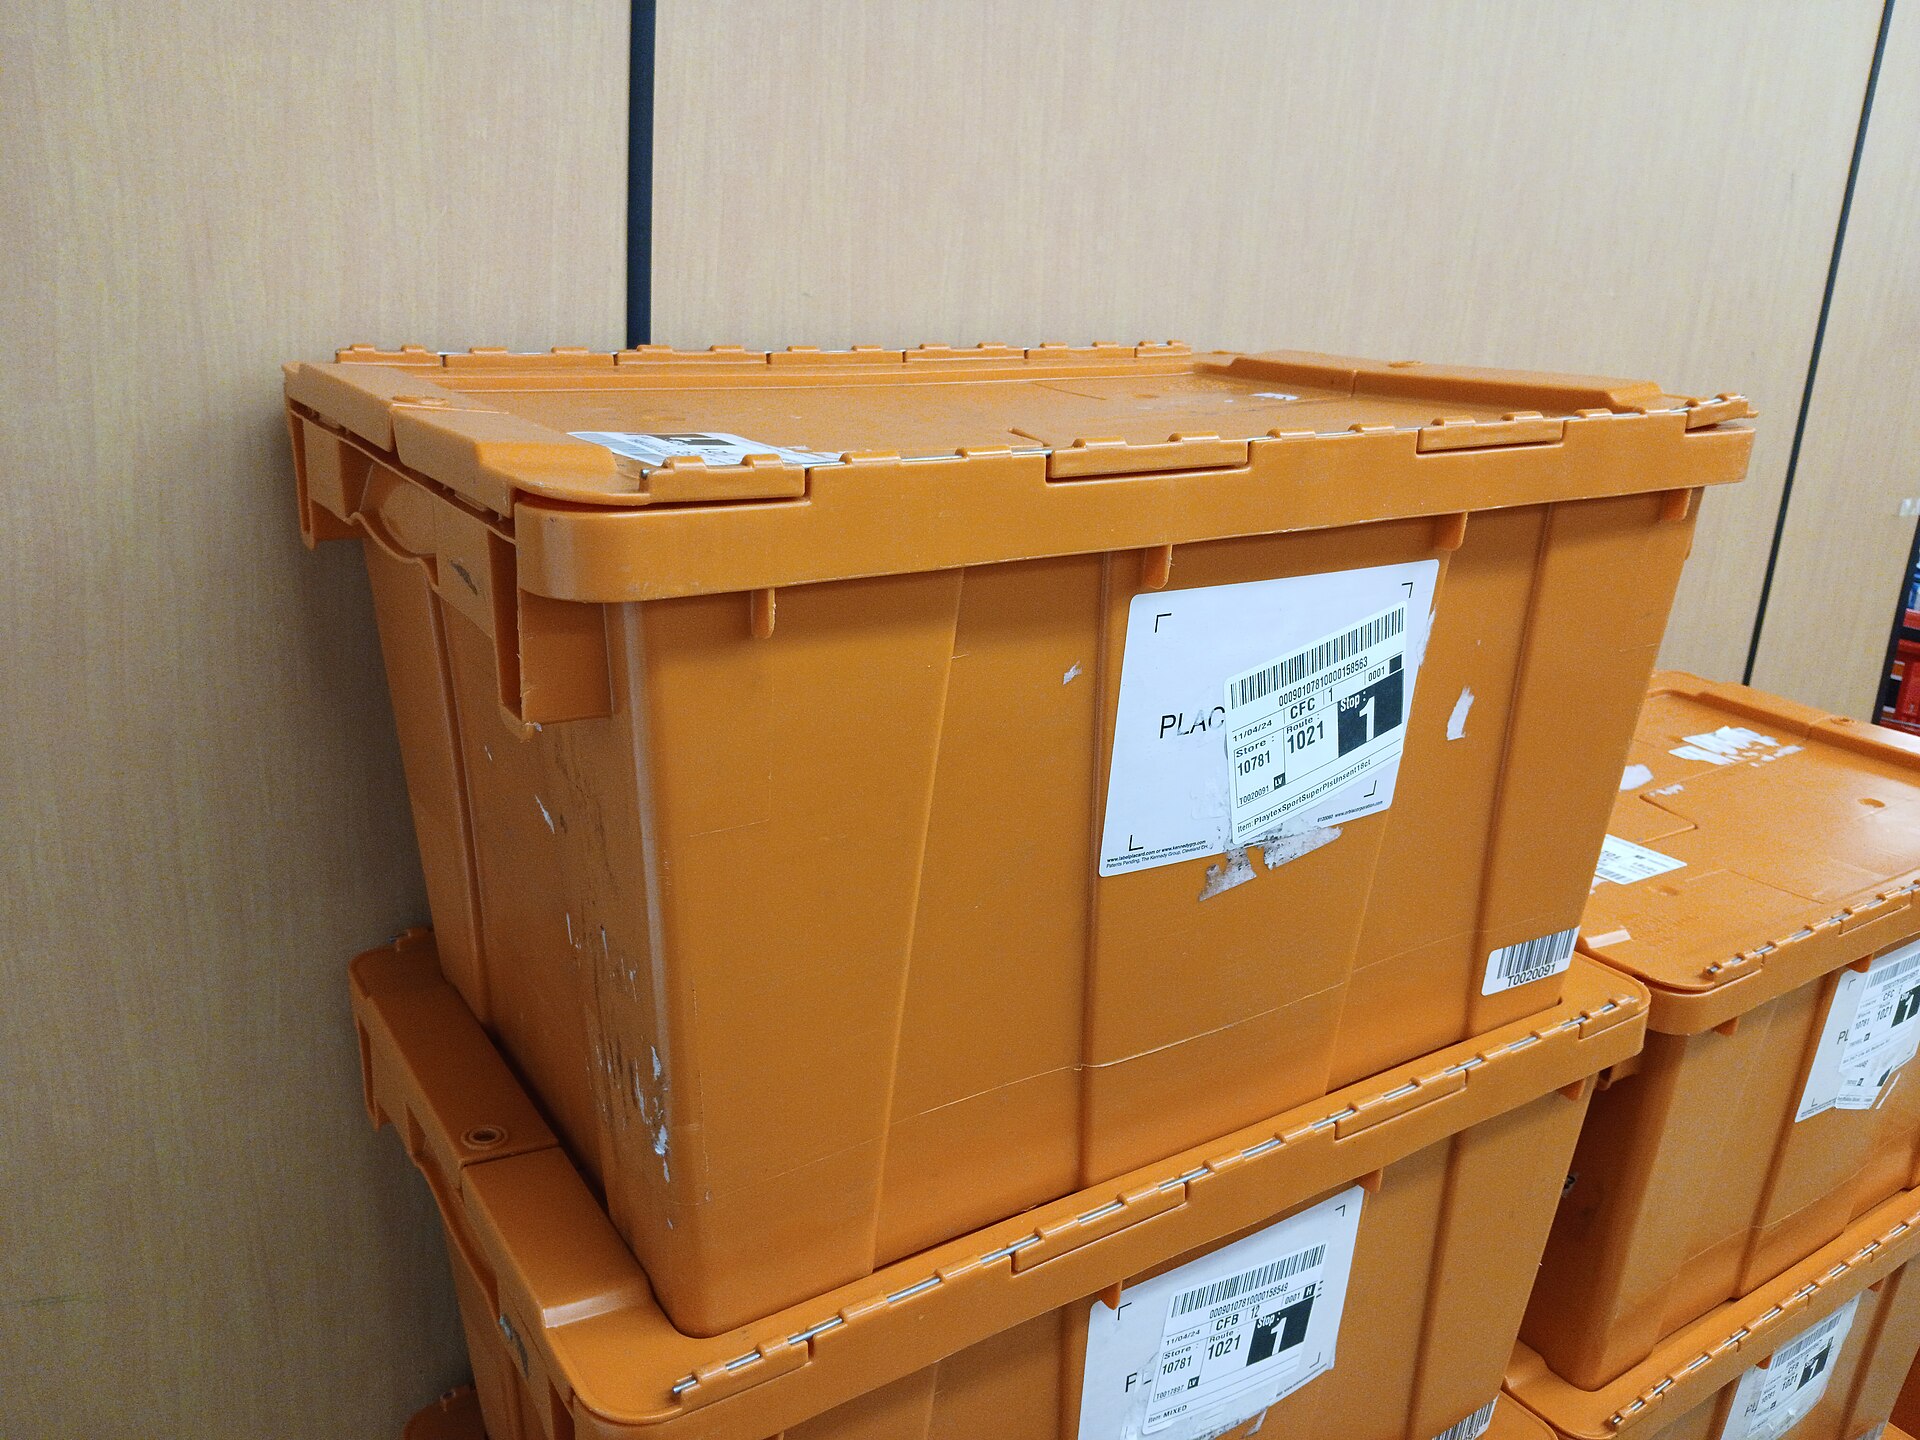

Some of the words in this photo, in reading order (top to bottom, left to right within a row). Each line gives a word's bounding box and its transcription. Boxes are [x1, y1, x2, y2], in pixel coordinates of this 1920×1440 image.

[1368, 665, 1385, 682] 0001
[1328, 686, 1334, 703] 1
[1340, 694, 1361, 713] Stop
[1290, 697, 1316, 720] CFC
[1359, 695, 1375, 742] 1
[1232, 719, 1273, 742] 11/04/24
[1286, 717, 1314, 735] Route
[1286, 719, 1324, 755] 1021
[1235, 739, 1267, 759] Store
[1237, 750, 1271, 777] 10781
[1239, 784, 1270, 805] T0020091
[1507, 963, 1556, 988] T0020091
[1876, 1004, 1894, 1022] 1021
[1905, 994, 1915, 1022] 1
[1215, 1313, 1240, 1331] CFB
[1250, 1304, 1261, 1320] 12
[1257, 1313, 1275, 1329] Stop
[1166, 1329, 1201, 1346] 11/04/24
[1209, 1330, 1234, 1344] Route
[1270, 1316, 1288, 1356] 1
[1163, 1345, 1192, 1360] Store
[1207, 1333, 1242, 1361] 1021
[1162, 1354, 1193, 1376] 10781
[1808, 1358, 1819, 1380] 1
